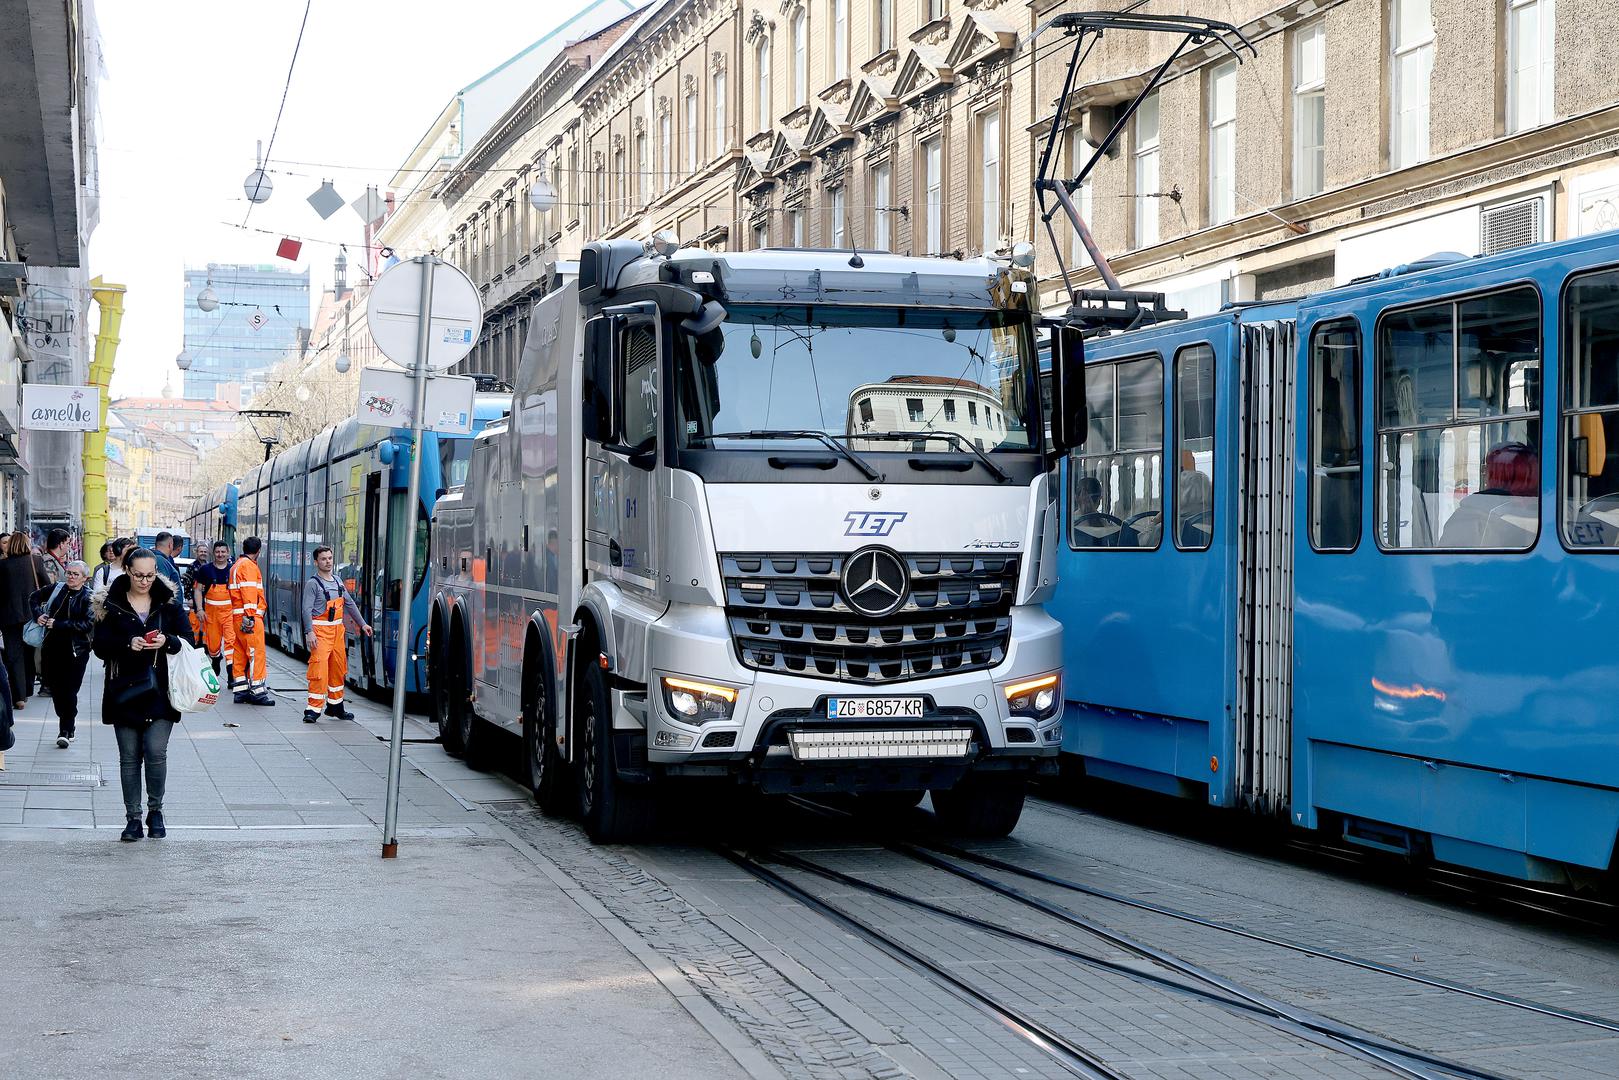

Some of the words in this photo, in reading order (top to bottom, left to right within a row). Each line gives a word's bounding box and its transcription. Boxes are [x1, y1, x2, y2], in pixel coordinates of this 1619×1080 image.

[254, 315, 261, 324] S
[31, 402, 91, 422] amelie
[843, 511, 908, 537] ZET
[838, 700, 856, 716] ZG
